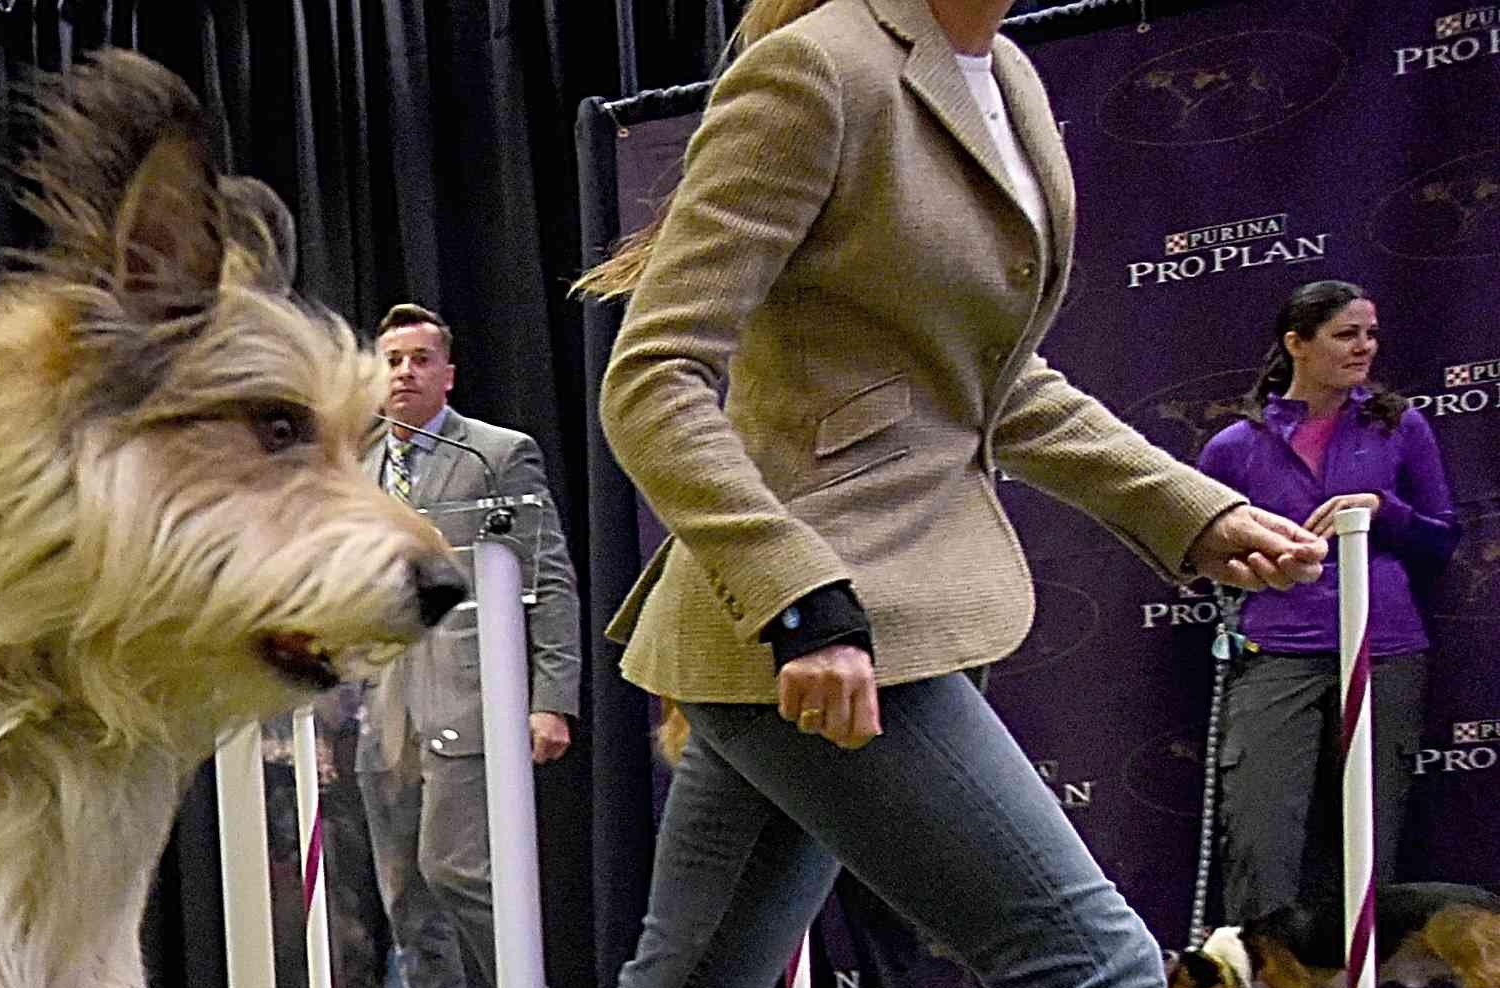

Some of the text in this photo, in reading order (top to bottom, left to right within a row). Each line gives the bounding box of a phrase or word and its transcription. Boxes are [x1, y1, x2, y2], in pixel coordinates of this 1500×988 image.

[1393, 36, 1480, 76] PRO
[1189, 218, 1280, 248] PURINA
[1126, 233, 1332, 289] PRO PLAN
[1405, 389, 1489, 417] PRO
[1140, 601, 1218, 629] PRO
[1412, 747, 1498, 775] PRO
